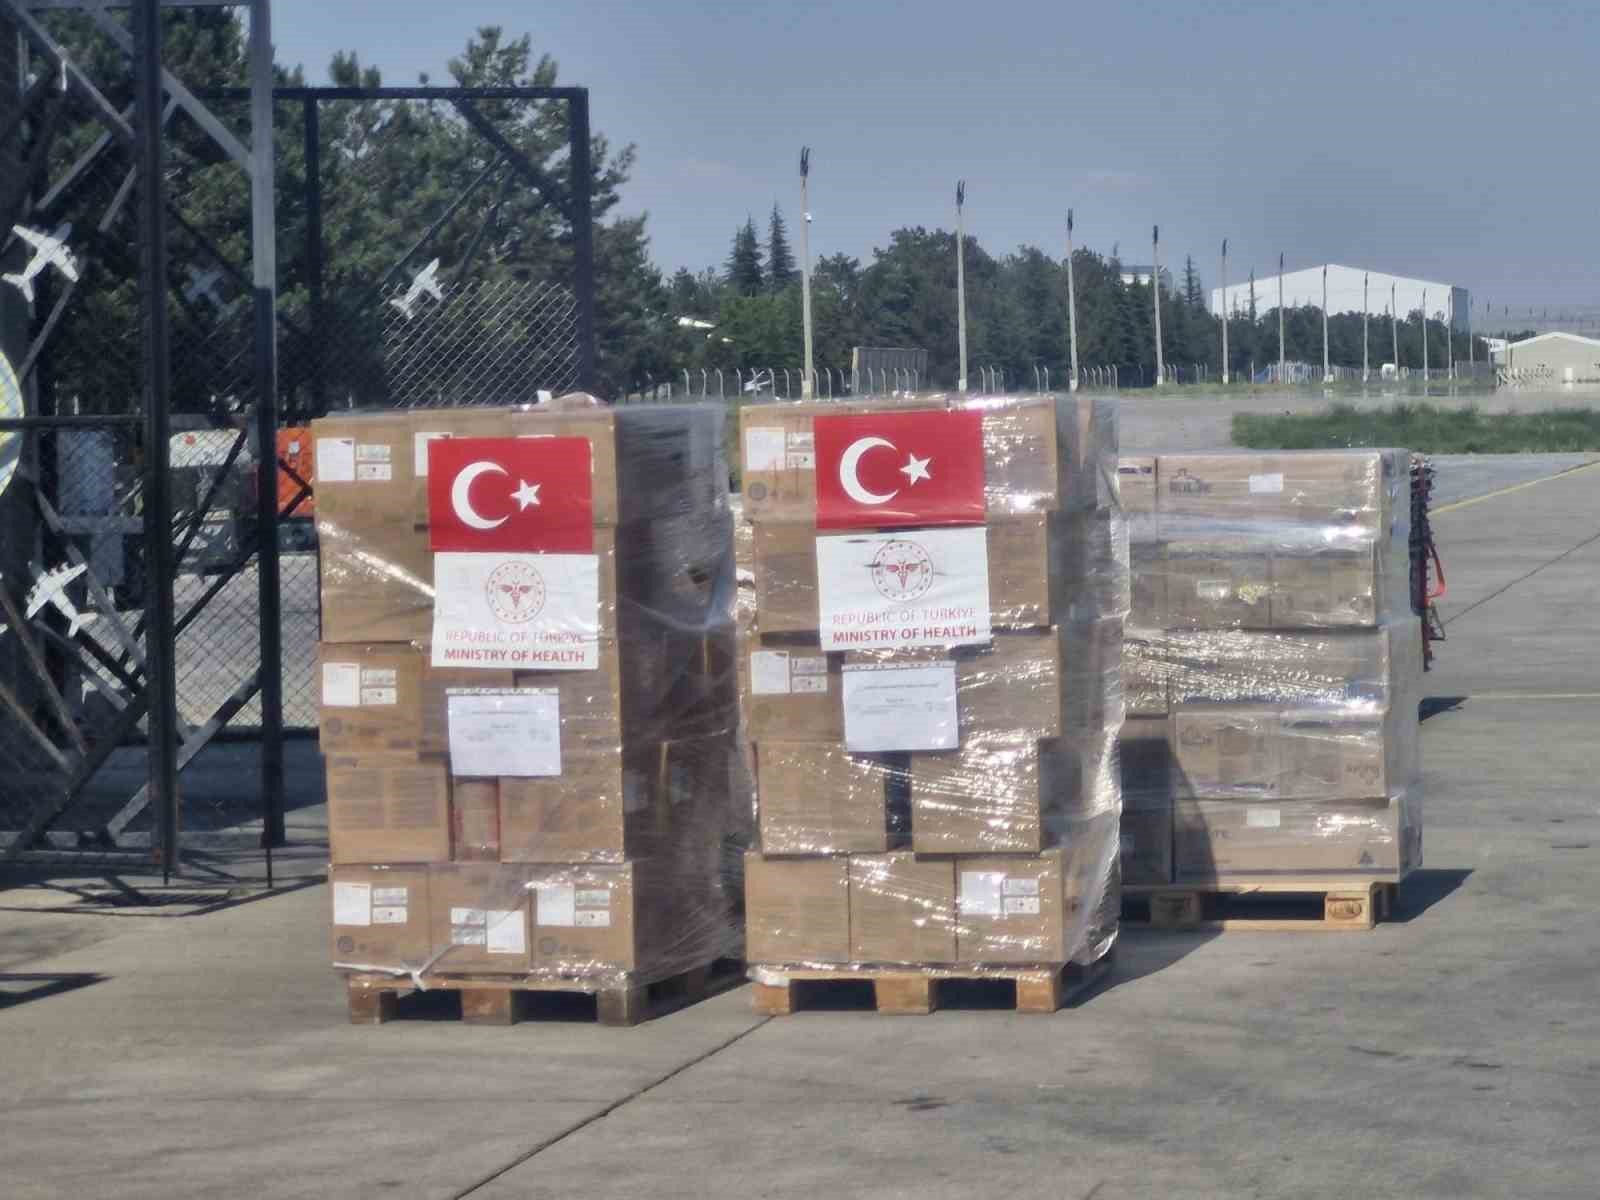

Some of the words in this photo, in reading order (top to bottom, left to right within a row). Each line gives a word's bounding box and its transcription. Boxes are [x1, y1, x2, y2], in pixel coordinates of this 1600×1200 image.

[900, 609, 916, 623] OF
[510, 631, 528, 643] OF
[832, 629, 897, 643] MINISTRY
[901, 627, 920, 640] OF
[924, 624, 977, 639] HEALTH
[445, 648, 507, 661] MINISTRY
[511, 650, 529, 662] OF
[533, 650, 585, 662] HEALTH
